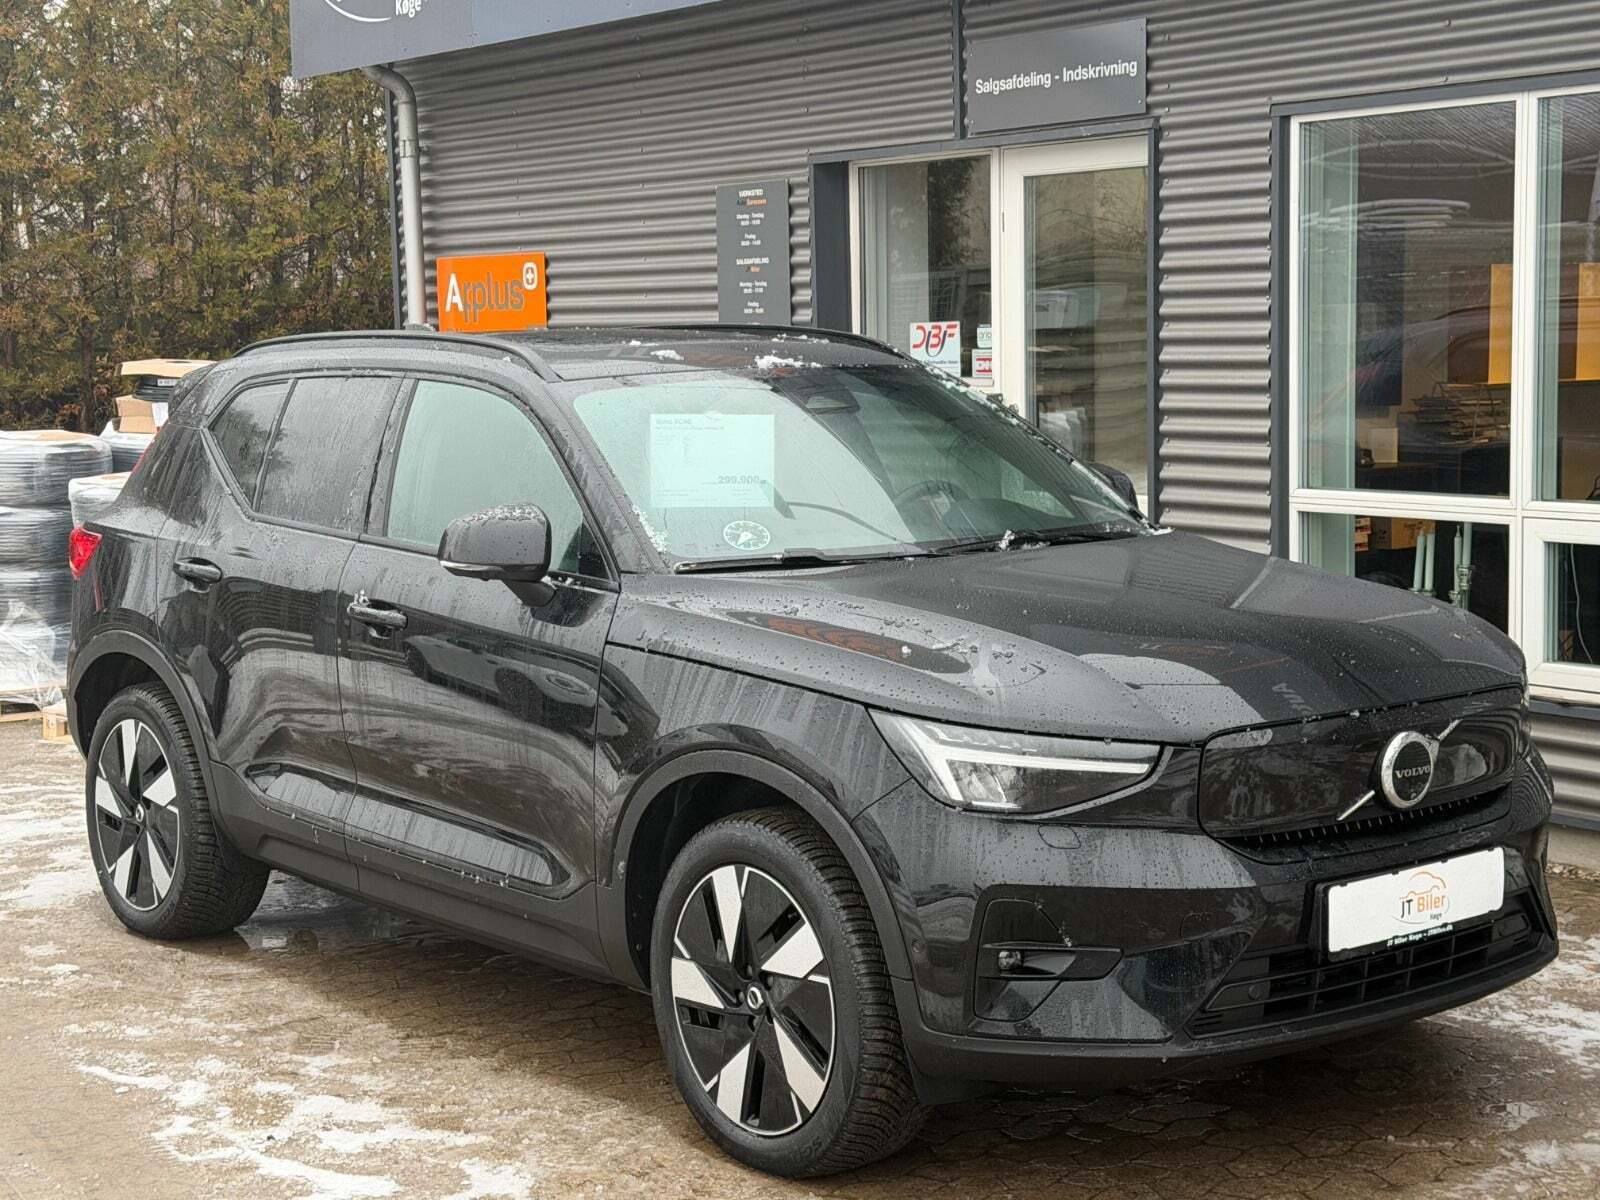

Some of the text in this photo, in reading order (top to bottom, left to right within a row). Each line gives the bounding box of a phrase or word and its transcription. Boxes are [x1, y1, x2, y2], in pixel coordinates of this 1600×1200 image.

[975, 72, 1051, 95] Salgsafdeling
[1063, 59, 1138, 82] Indskrivning
[1394, 765, 1431, 778] VOLVO
[1400, 894, 1446, 919] JT Biler
